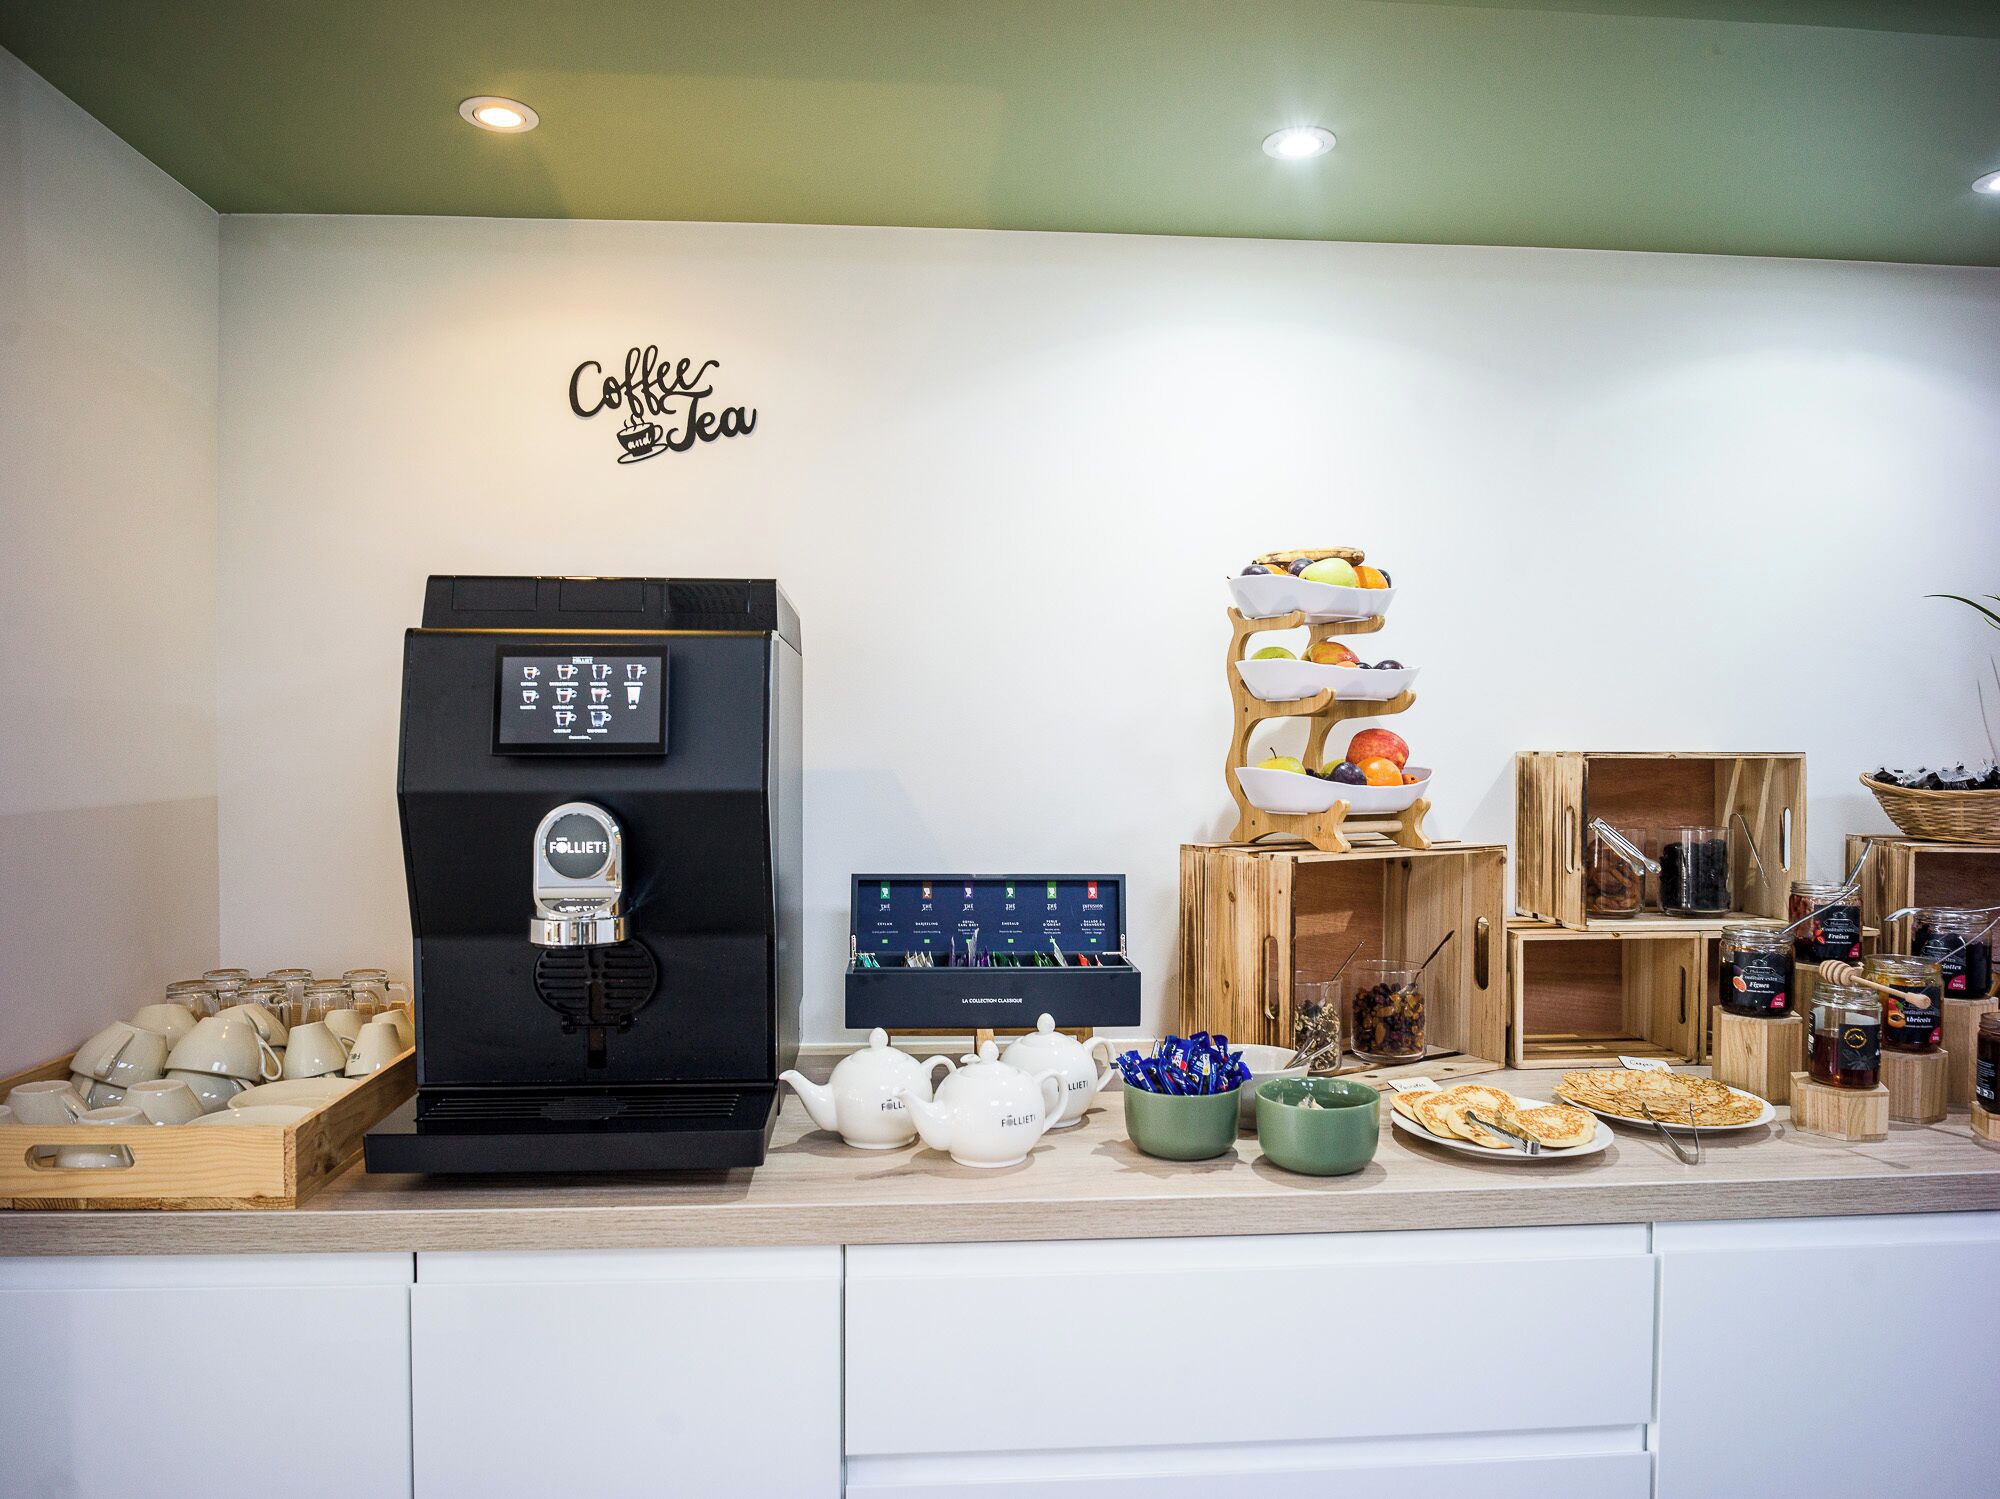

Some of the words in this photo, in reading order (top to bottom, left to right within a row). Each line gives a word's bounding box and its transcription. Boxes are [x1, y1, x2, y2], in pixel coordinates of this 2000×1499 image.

[569, 344, 720, 418] Coffee
[627, 433, 651, 450] and
[658, 384, 757, 452] Tea
[549, 840, 601, 854] FOLLIET
[1066, 1080, 1087, 1091] LLIET
[881, 1101, 906, 1111] FOLL
[1001, 1114, 1034, 1127] FOLLIET
